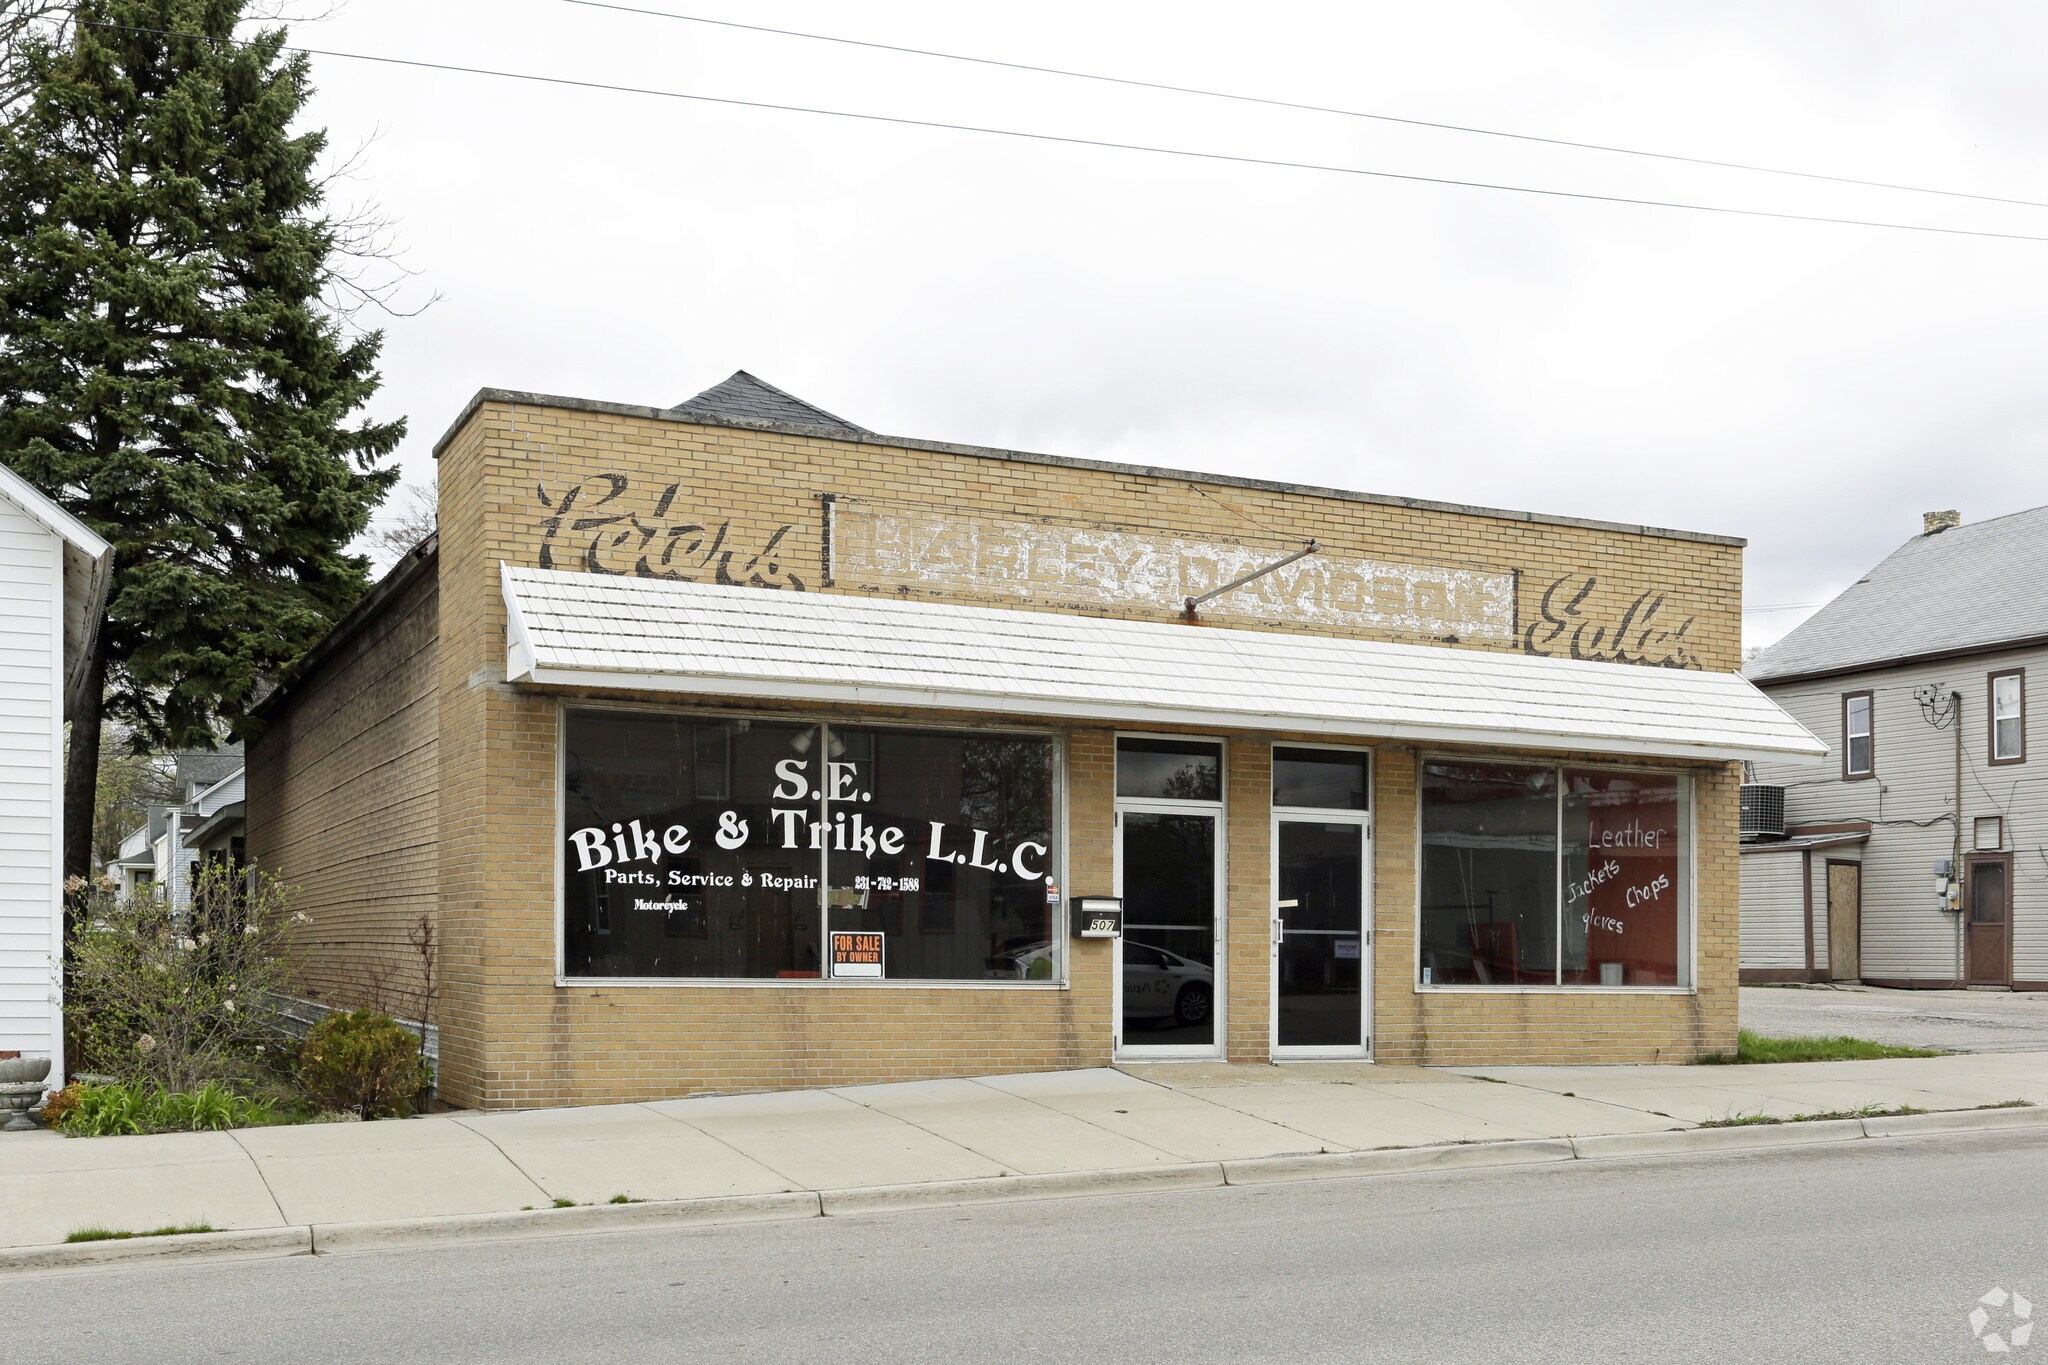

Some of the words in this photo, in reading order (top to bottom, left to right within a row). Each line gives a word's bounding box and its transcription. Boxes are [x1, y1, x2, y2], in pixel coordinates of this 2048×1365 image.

[772, 759, 871, 802] S.E.
[568, 819, 691, 872] Bike
[715, 810, 749, 850] &
[771, 808, 905, 859] Trike
[1589, 818, 1667, 849] Leather
[605, 869, 661, 887] Parts,
[668, 870, 734, 886] Service
[741, 872, 753, 887] &
[760, 873, 818, 891] Repair
[1568, 860, 1620, 903] Jackets
[1626, 874, 1669, 908] Chaps
[634, 899, 688, 913] Motorcycle
[1091, 920, 1115, 930] 507
[834, 935, 853, 951] FOR
[856, 935, 880, 951] SALE
[836, 952, 847, 962] BY
[849, 952, 879, 962] OWNER
